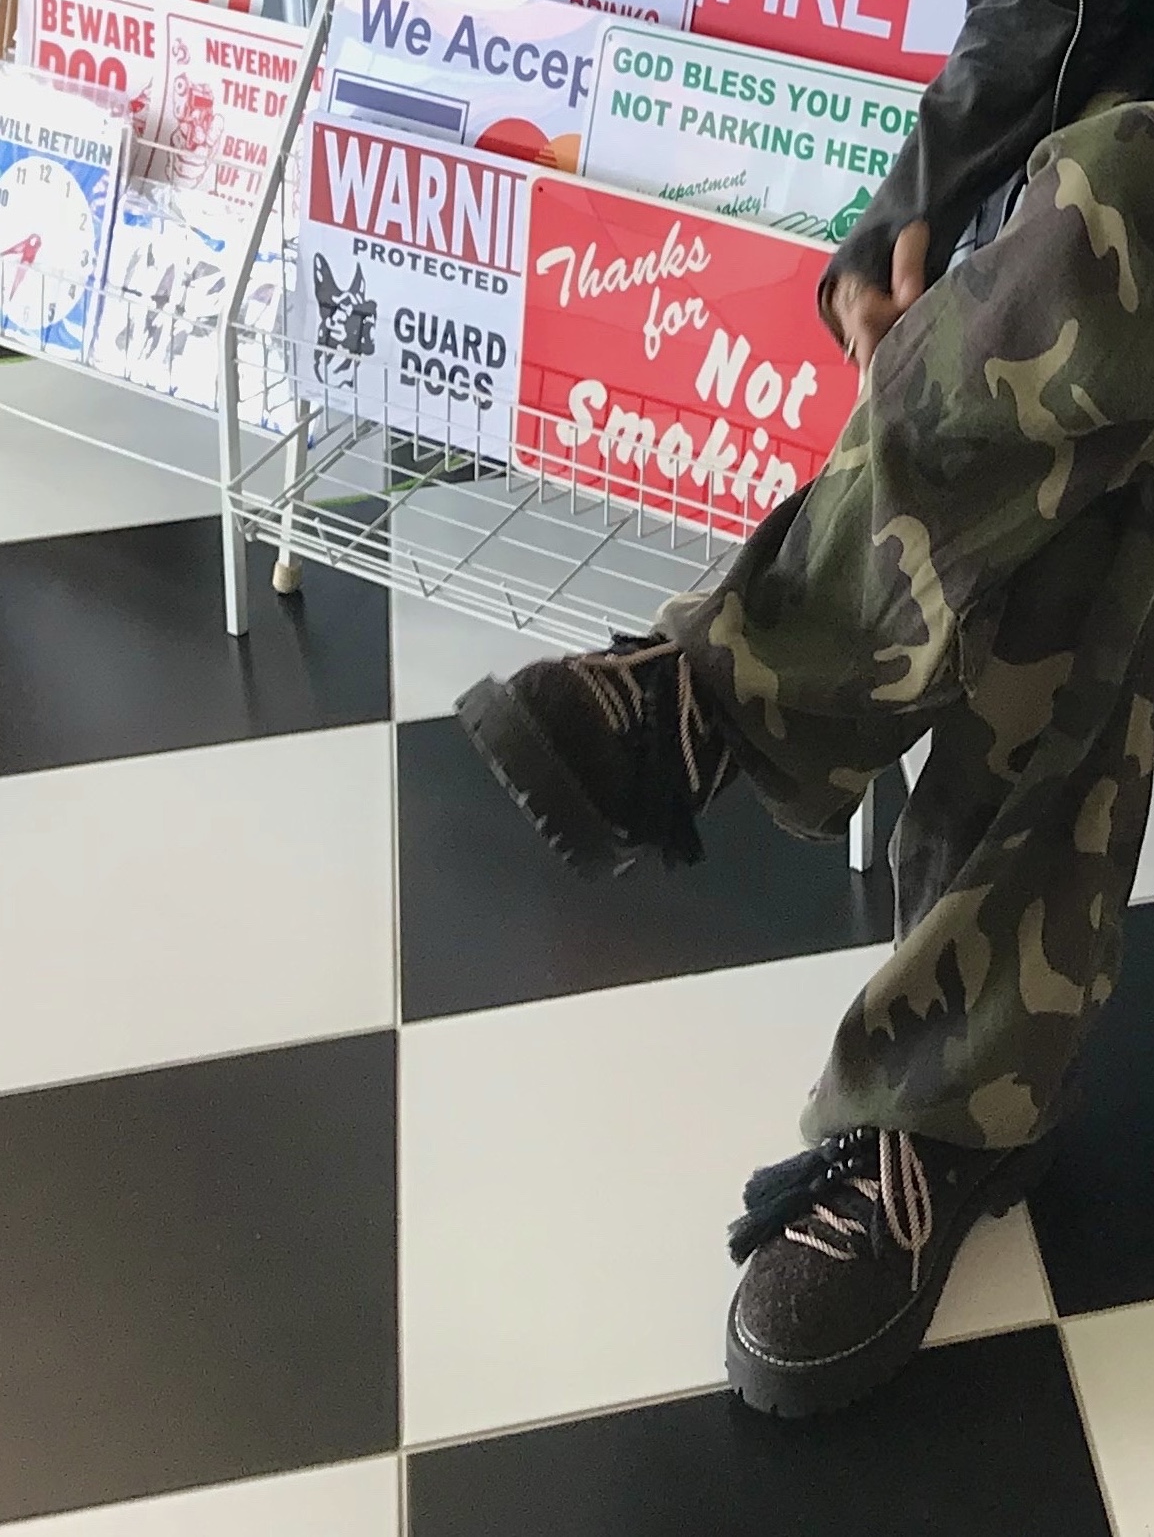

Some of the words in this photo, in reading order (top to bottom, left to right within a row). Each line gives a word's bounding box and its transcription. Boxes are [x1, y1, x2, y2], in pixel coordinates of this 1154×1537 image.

[221, 78, 261, 113] THE
[613, 47, 674, 82] GOD
[682, 61, 776, 106] BLESS
[787, 83, 852, 123] YOU
[37, 127, 113, 166] RETURN
[611, 89, 672, 126] NOT
[680, 105, 814, 161] PARKING
[824, 138, 899, 178] HER
[658, 169, 747, 202] department
[353, 237, 508, 295] PROTECTED
[536, 220, 712, 308] Thanks
[394, 307, 507, 369] GUARD
[643, 287, 710, 360] for
[400, 348, 494, 411] DOGS
[695, 328, 818, 430] Not
